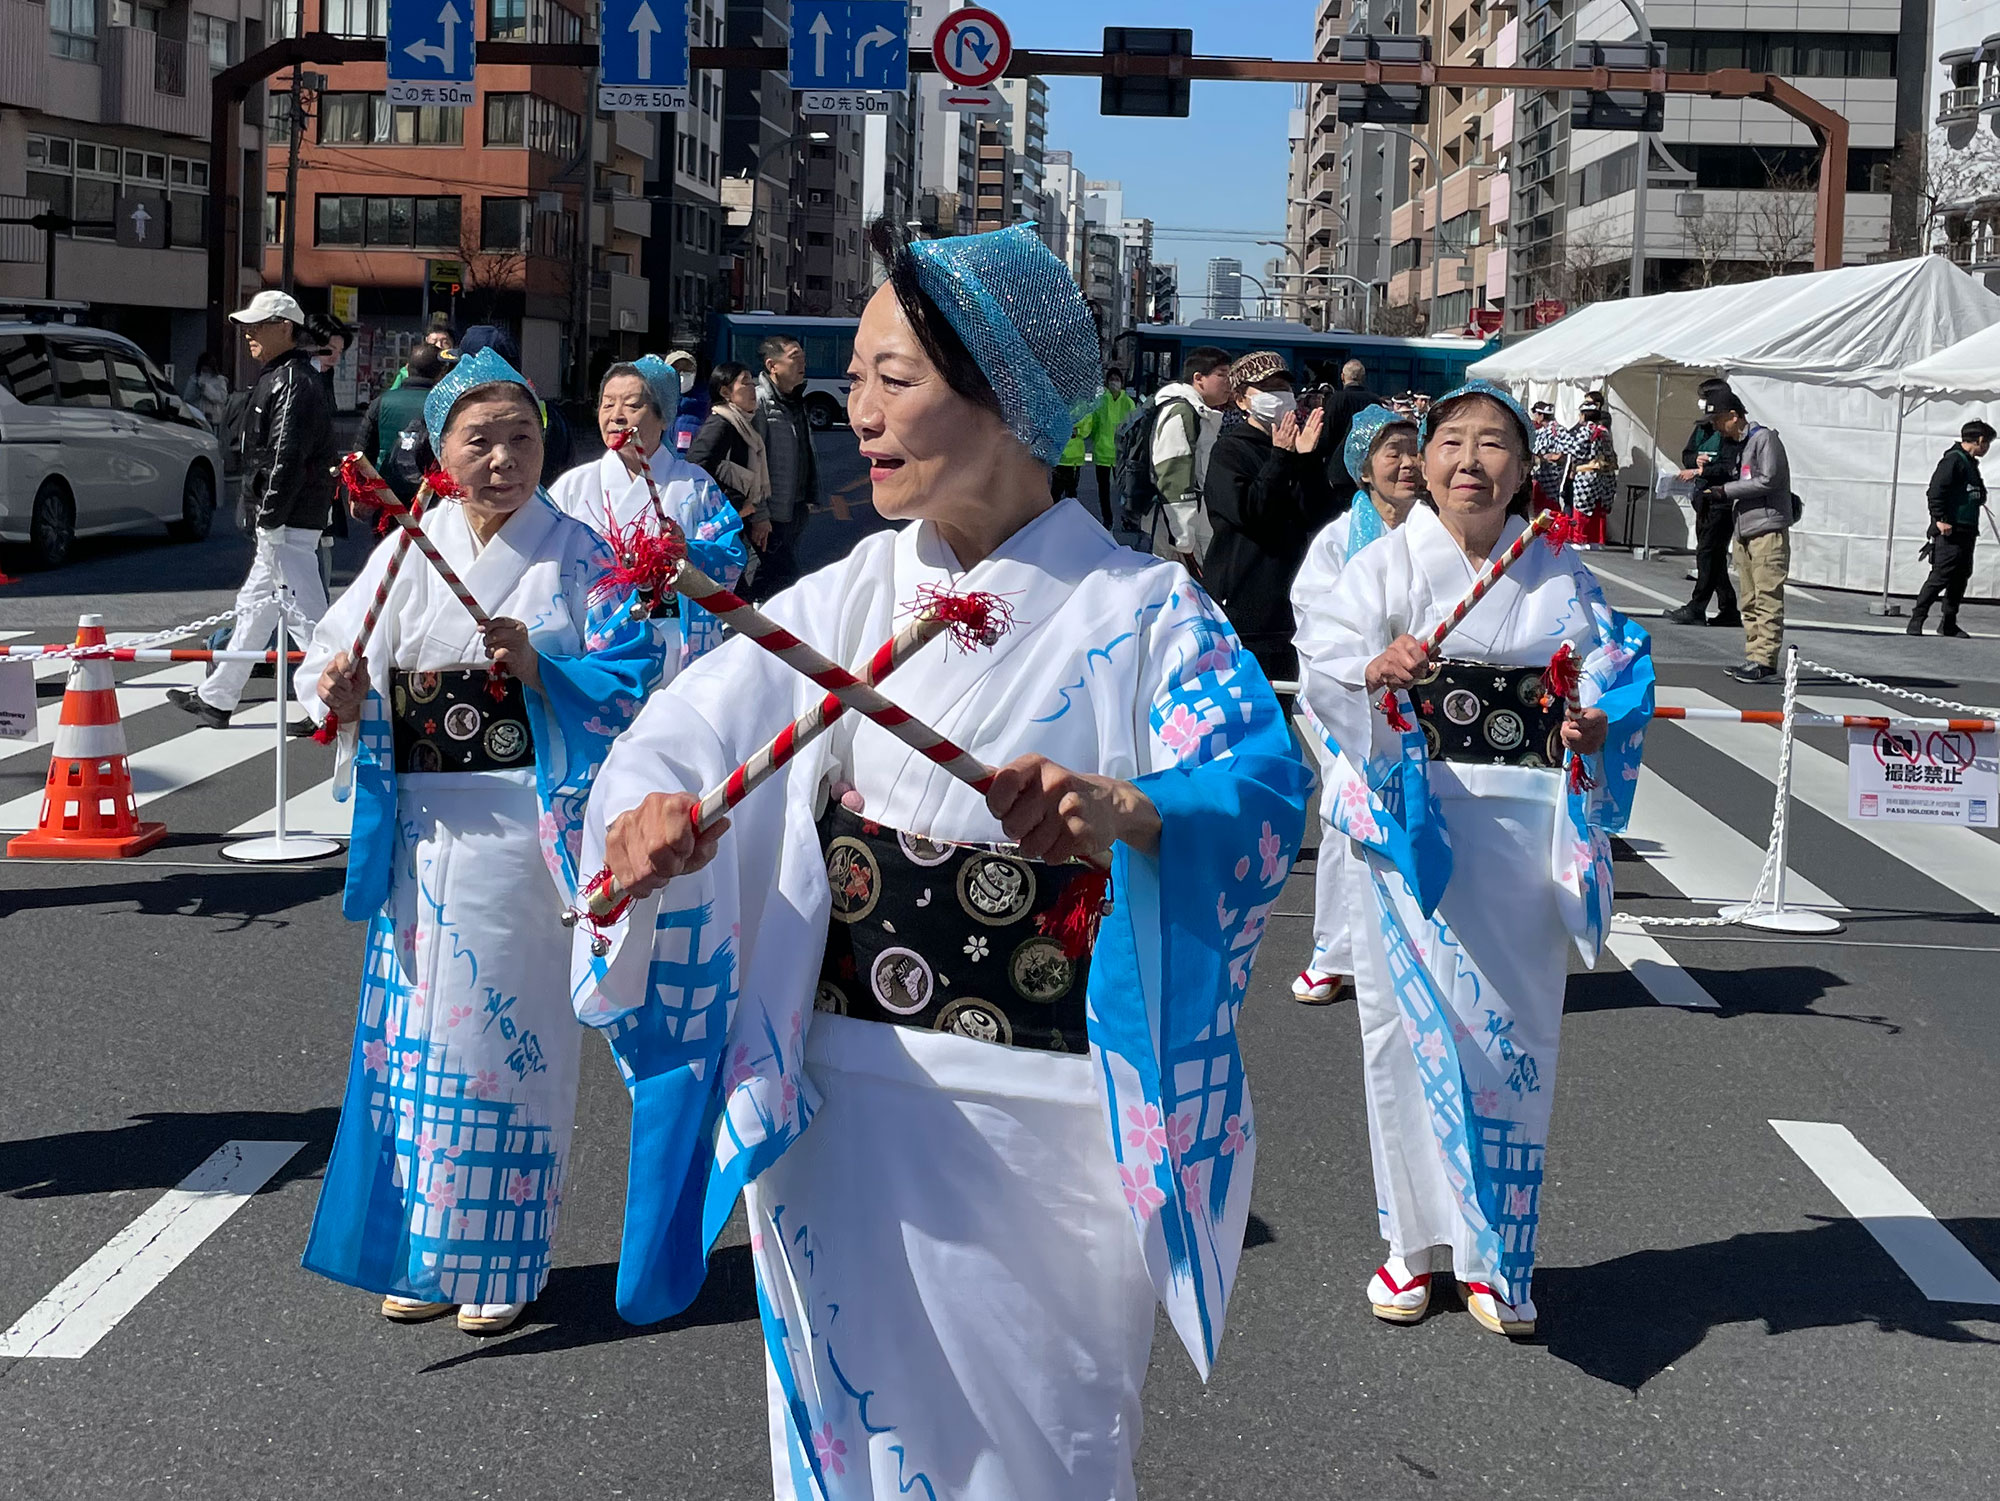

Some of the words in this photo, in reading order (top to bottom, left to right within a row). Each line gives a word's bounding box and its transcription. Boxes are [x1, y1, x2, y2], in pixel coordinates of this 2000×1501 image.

[450, 283, 461, 296] P
[1884, 763, 1963, 785] 撮影禁止
[1907, 808, 1940, 816] HOLDERS
